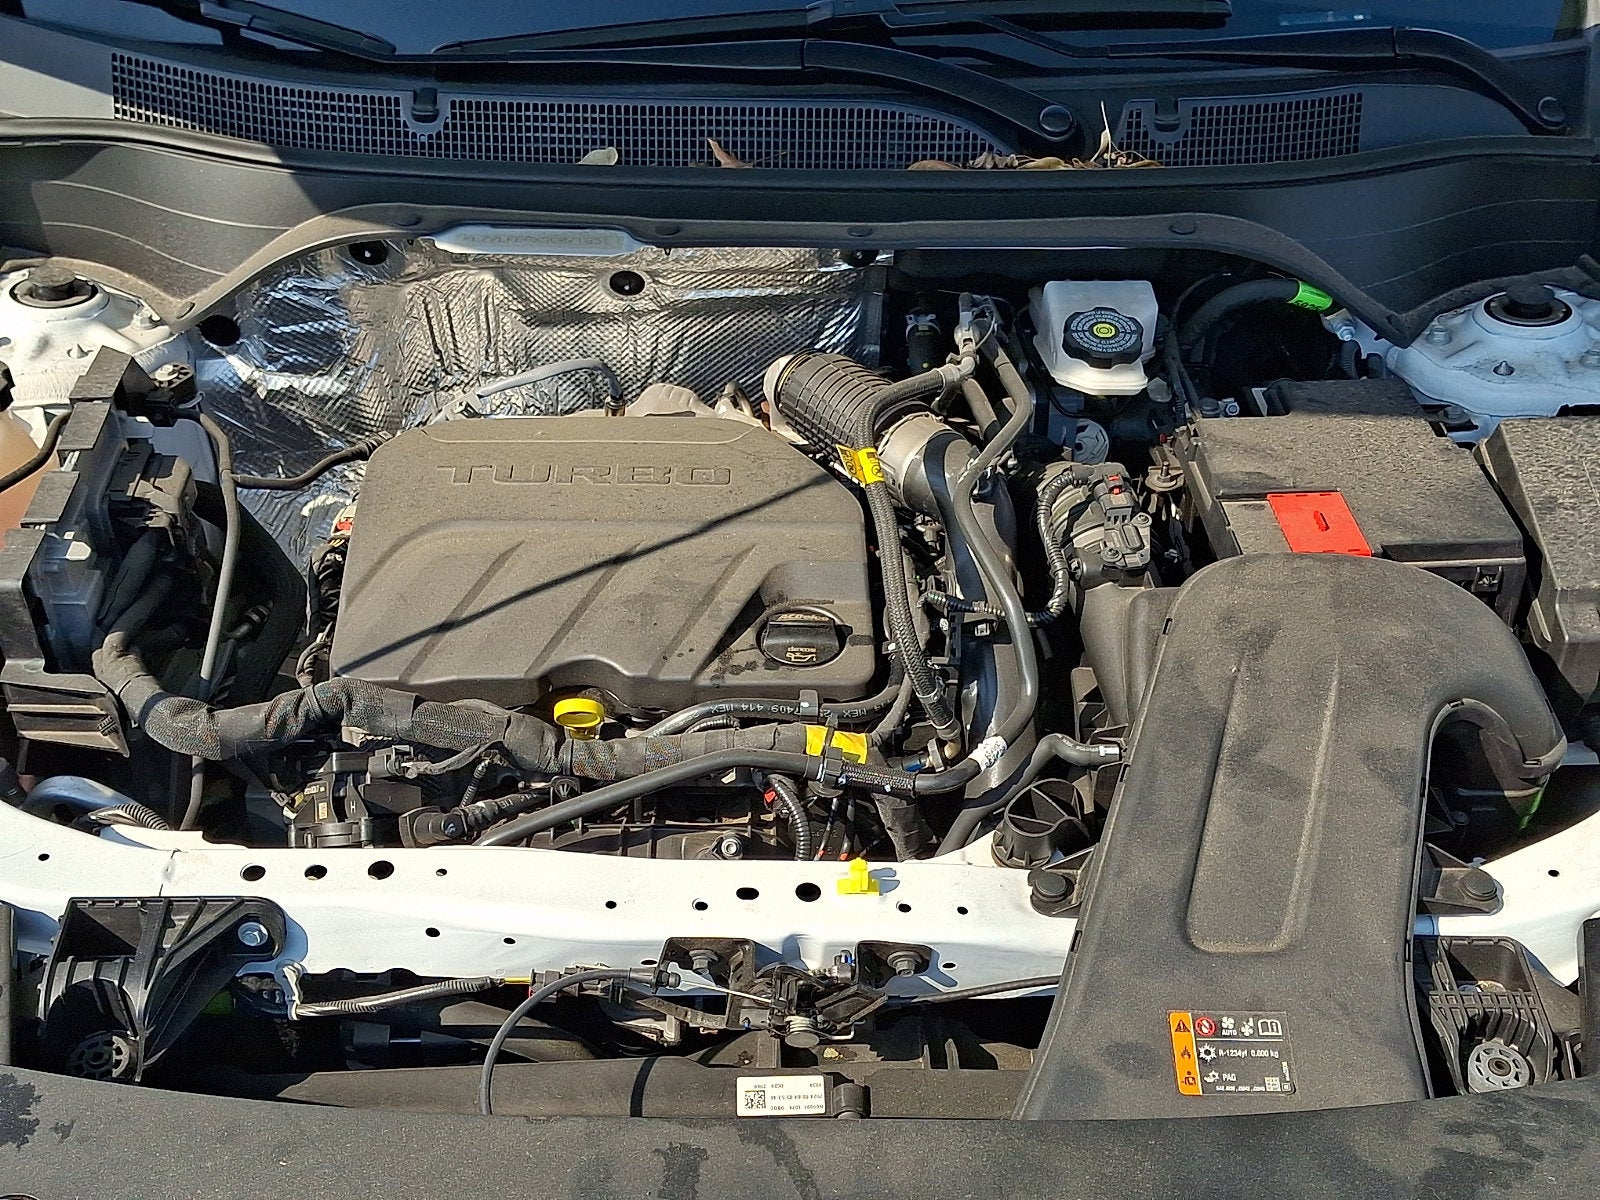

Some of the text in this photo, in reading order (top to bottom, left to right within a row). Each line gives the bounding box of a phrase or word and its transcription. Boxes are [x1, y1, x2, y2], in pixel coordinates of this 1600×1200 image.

[436, 464, 731, 486] TURBO
[776, 613, 830, 622] ACDelco
[710, 703, 734, 714] MEX
[842, 707, 867, 719] MEX
[350, 800, 356, 814] H
[1270, 1049, 1279, 1058] kg
